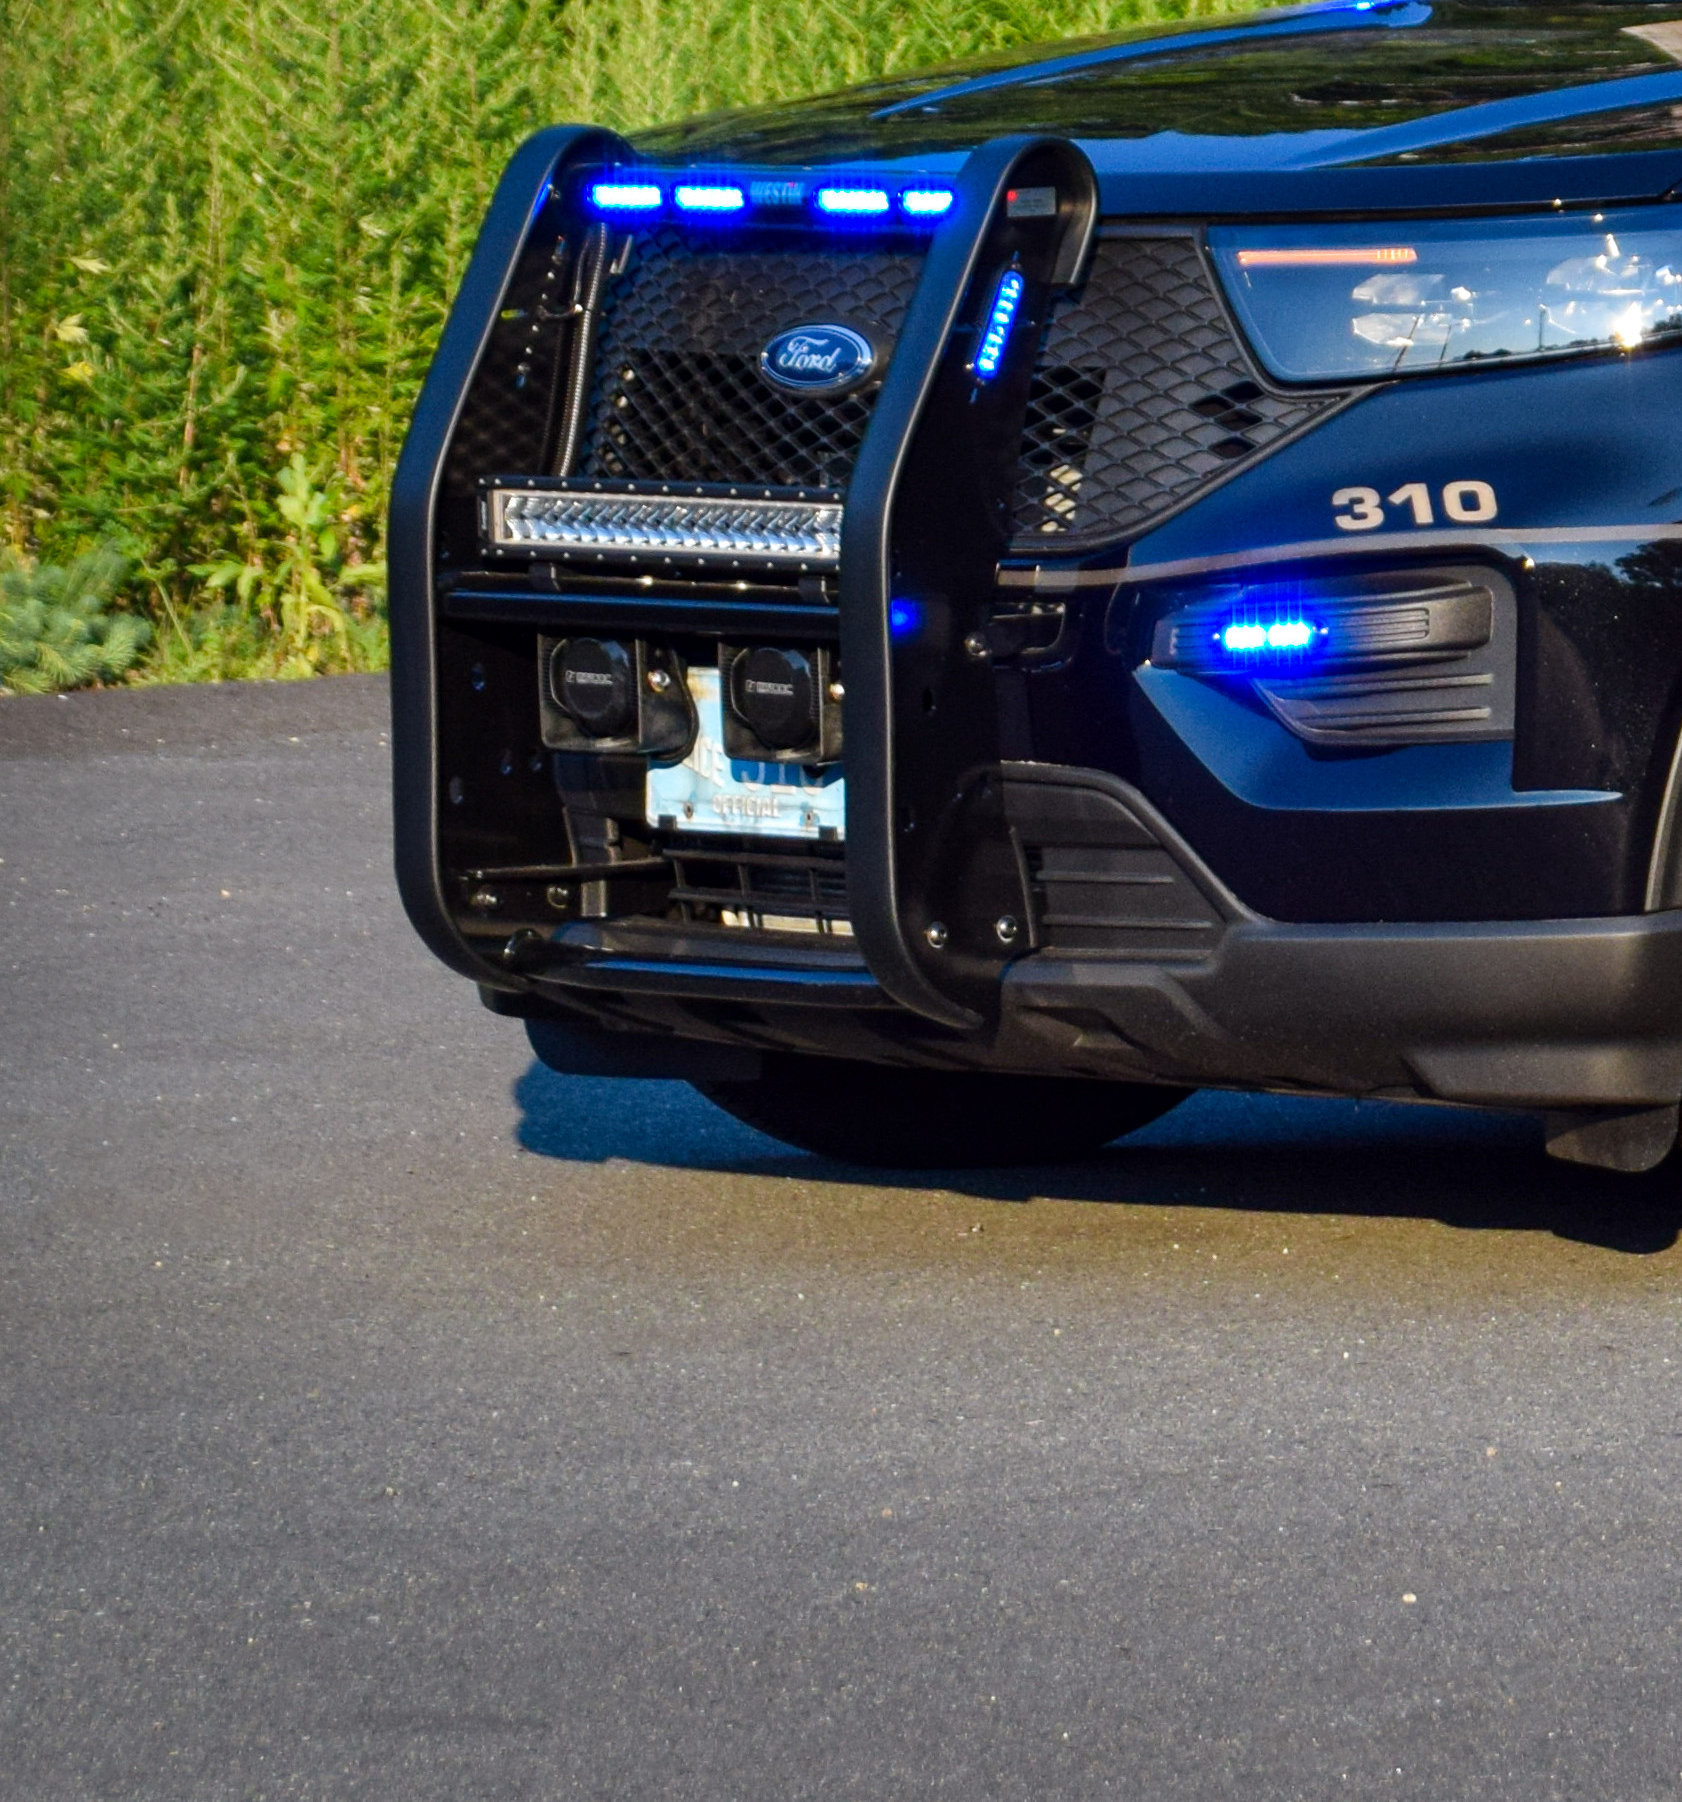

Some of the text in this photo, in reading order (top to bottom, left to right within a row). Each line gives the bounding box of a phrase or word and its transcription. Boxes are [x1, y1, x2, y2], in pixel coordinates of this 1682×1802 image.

[779, 336, 841, 374] Ford
[1331, 480, 1498, 531] 310
[712, 794, 780, 819] OFFICIAL
